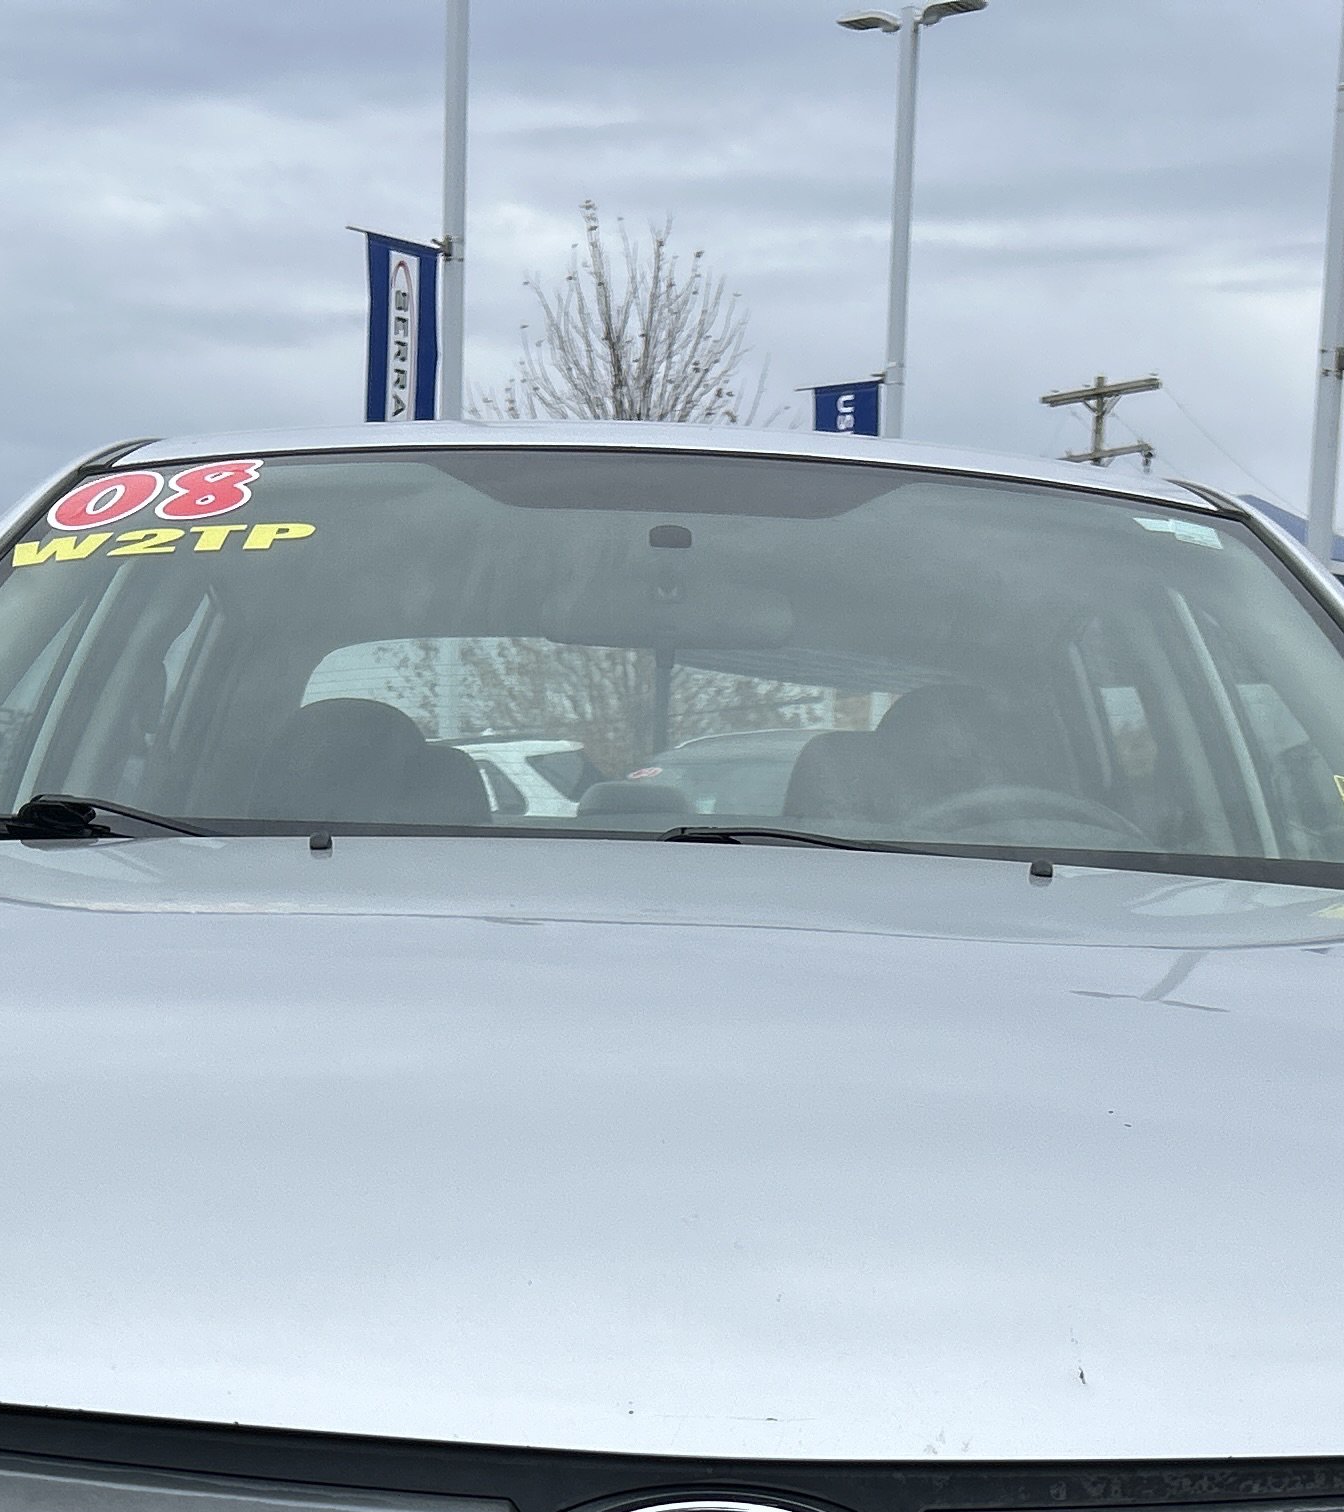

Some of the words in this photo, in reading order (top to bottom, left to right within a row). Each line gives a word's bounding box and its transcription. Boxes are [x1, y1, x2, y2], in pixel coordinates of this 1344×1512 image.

[392, 290, 408, 417] SERRA
[837, 394, 855, 433] US
[47, 459, 264, 531] 08
[12, 523, 316, 567] W2TP
